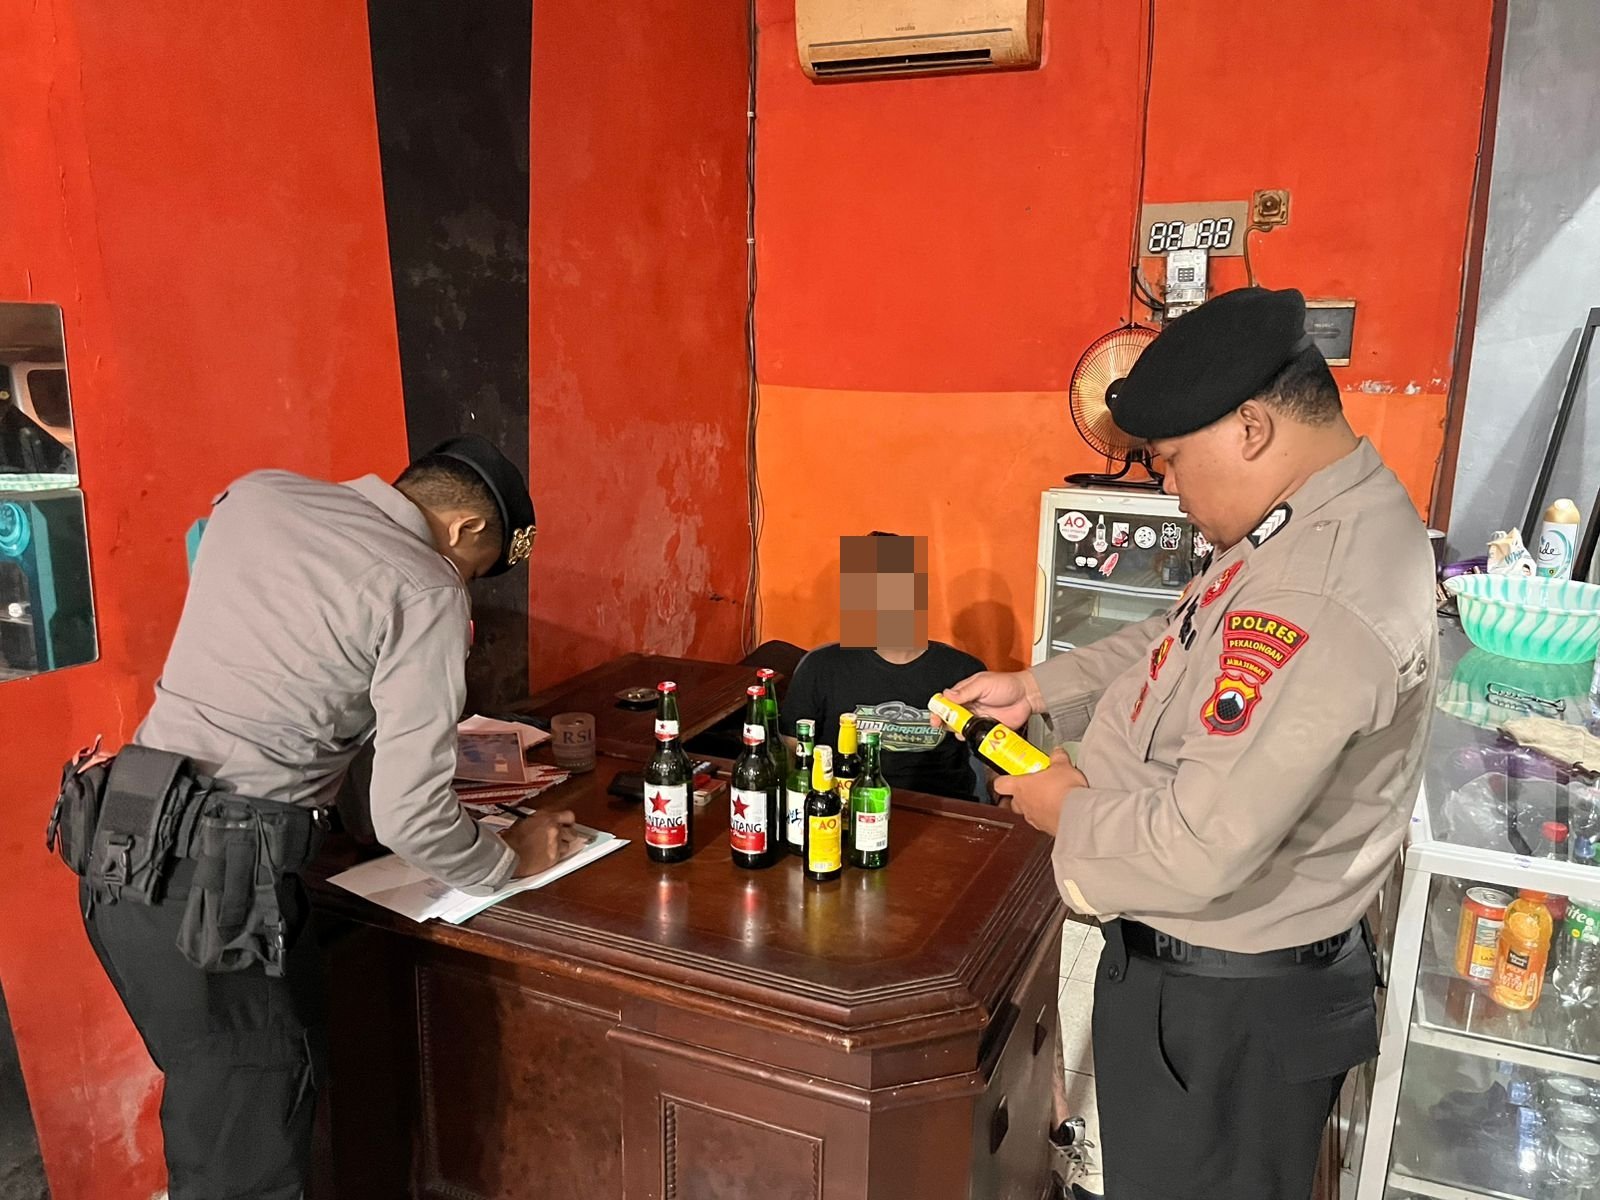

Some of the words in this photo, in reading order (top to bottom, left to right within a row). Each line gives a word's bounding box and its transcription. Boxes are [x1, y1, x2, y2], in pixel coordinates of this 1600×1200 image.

[1064, 516, 1086, 528] AO
[1231, 616, 1298, 645] POLRES
[1229, 639, 1284, 662] PEKALONGAN
[988, 729, 1007, 751] AO
[818, 818, 837, 831] AO
